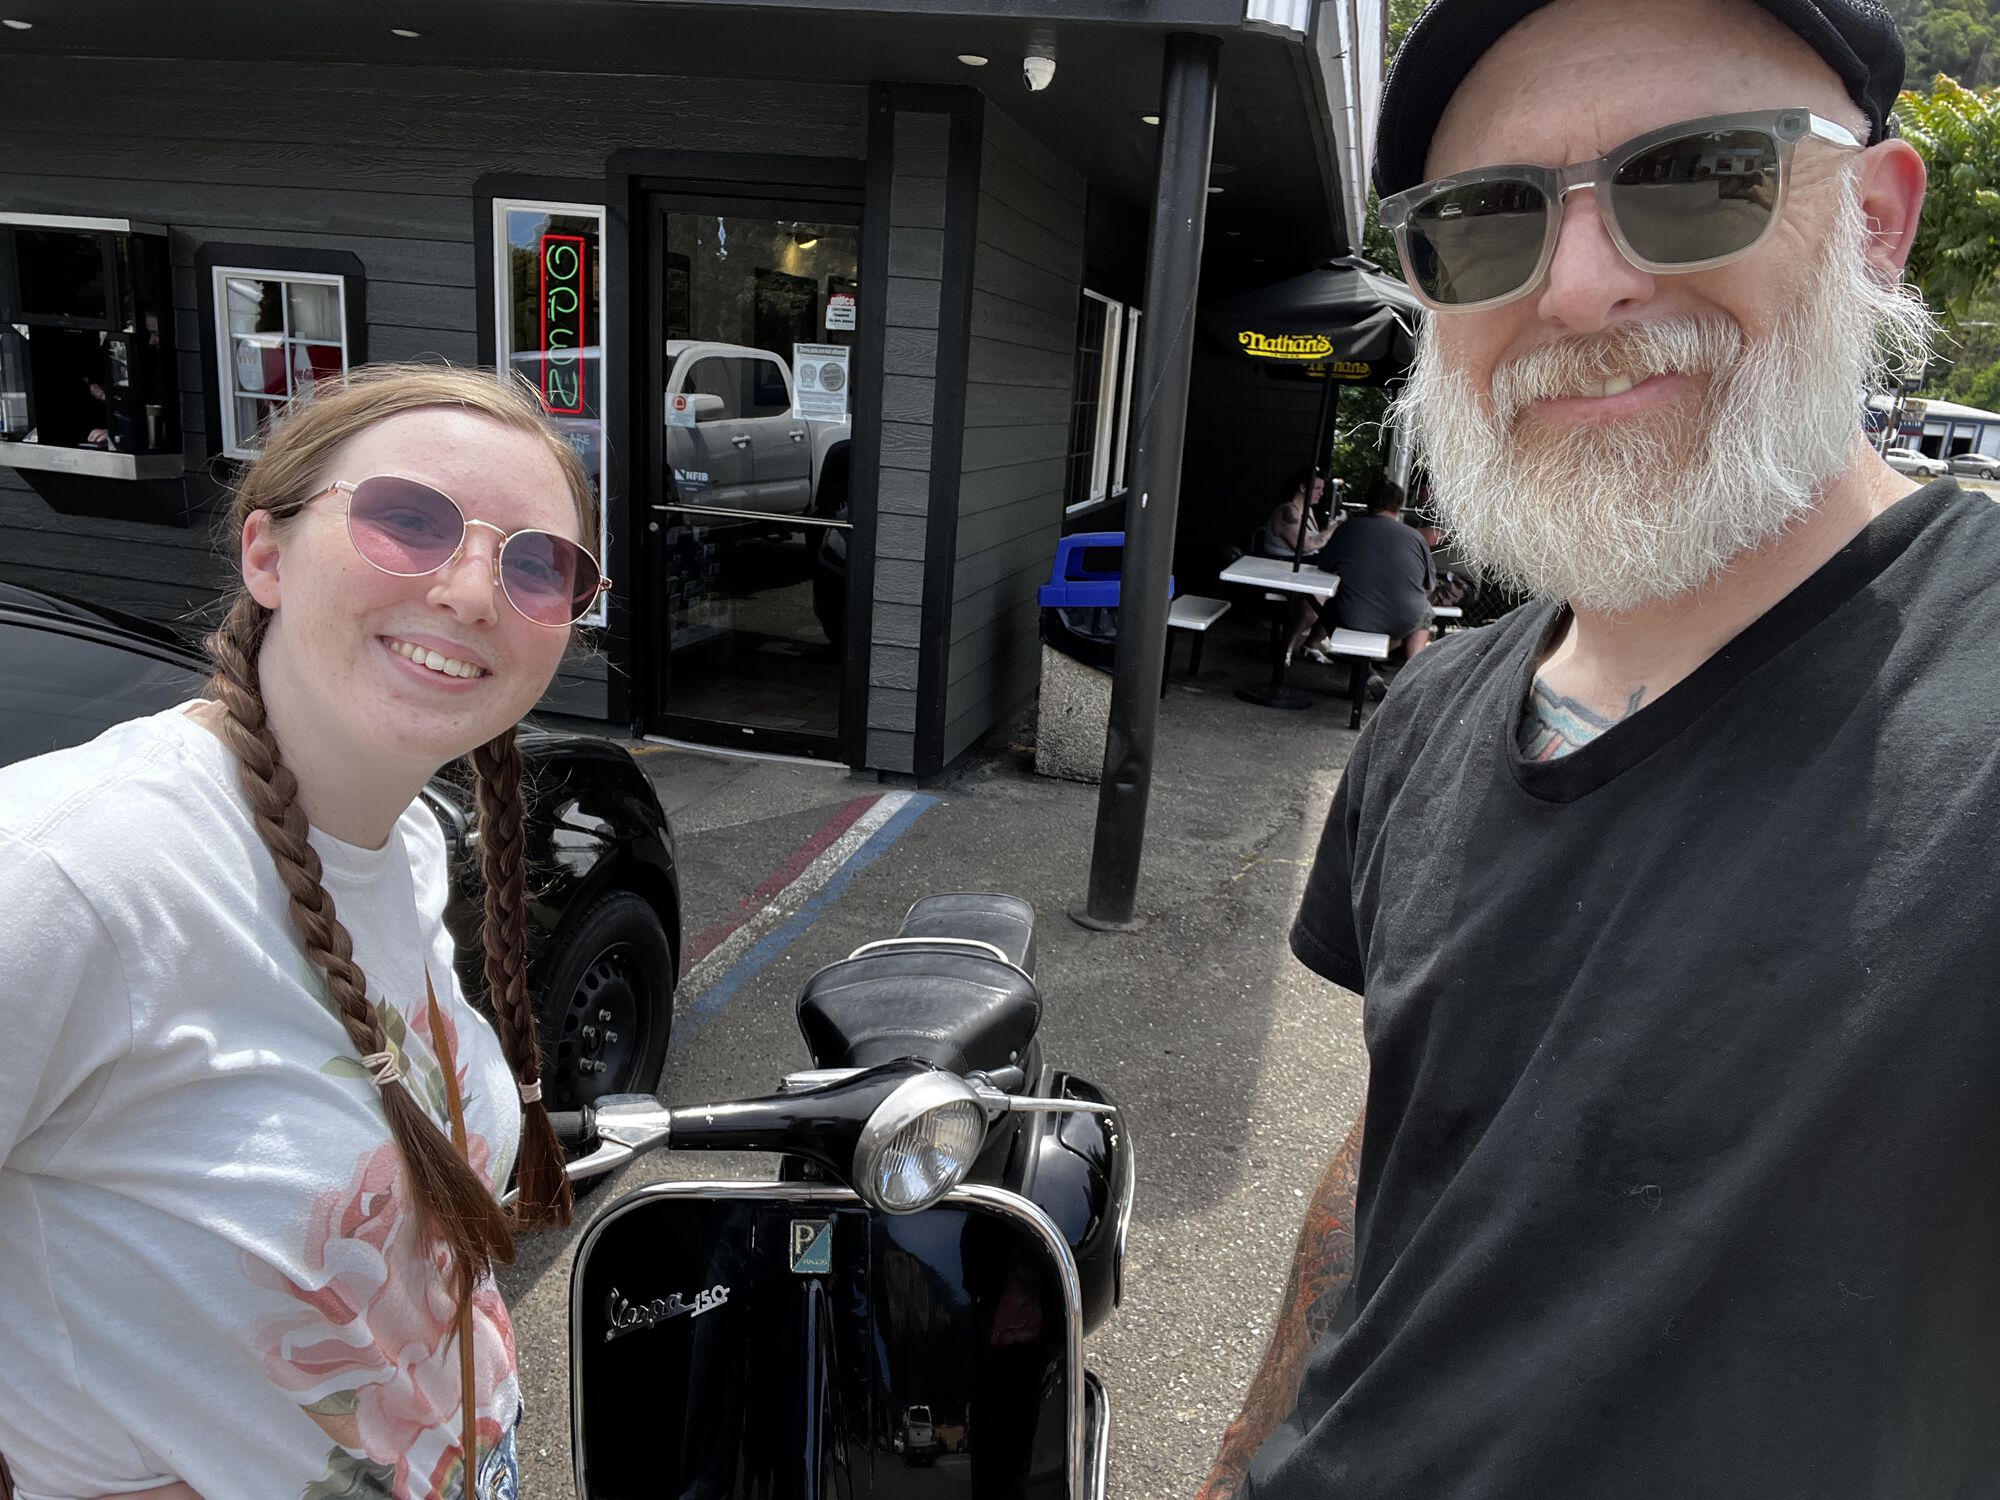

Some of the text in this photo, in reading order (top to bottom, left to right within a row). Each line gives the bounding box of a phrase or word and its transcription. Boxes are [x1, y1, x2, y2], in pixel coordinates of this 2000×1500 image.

[546, 244, 578, 407] OPEN
[1238, 331, 1334, 354] Nathan's
[686, 471, 709, 482] NFIB
[795, 1225, 815, 1255] P
[605, 1284, 731, 1335] Vespa 150
